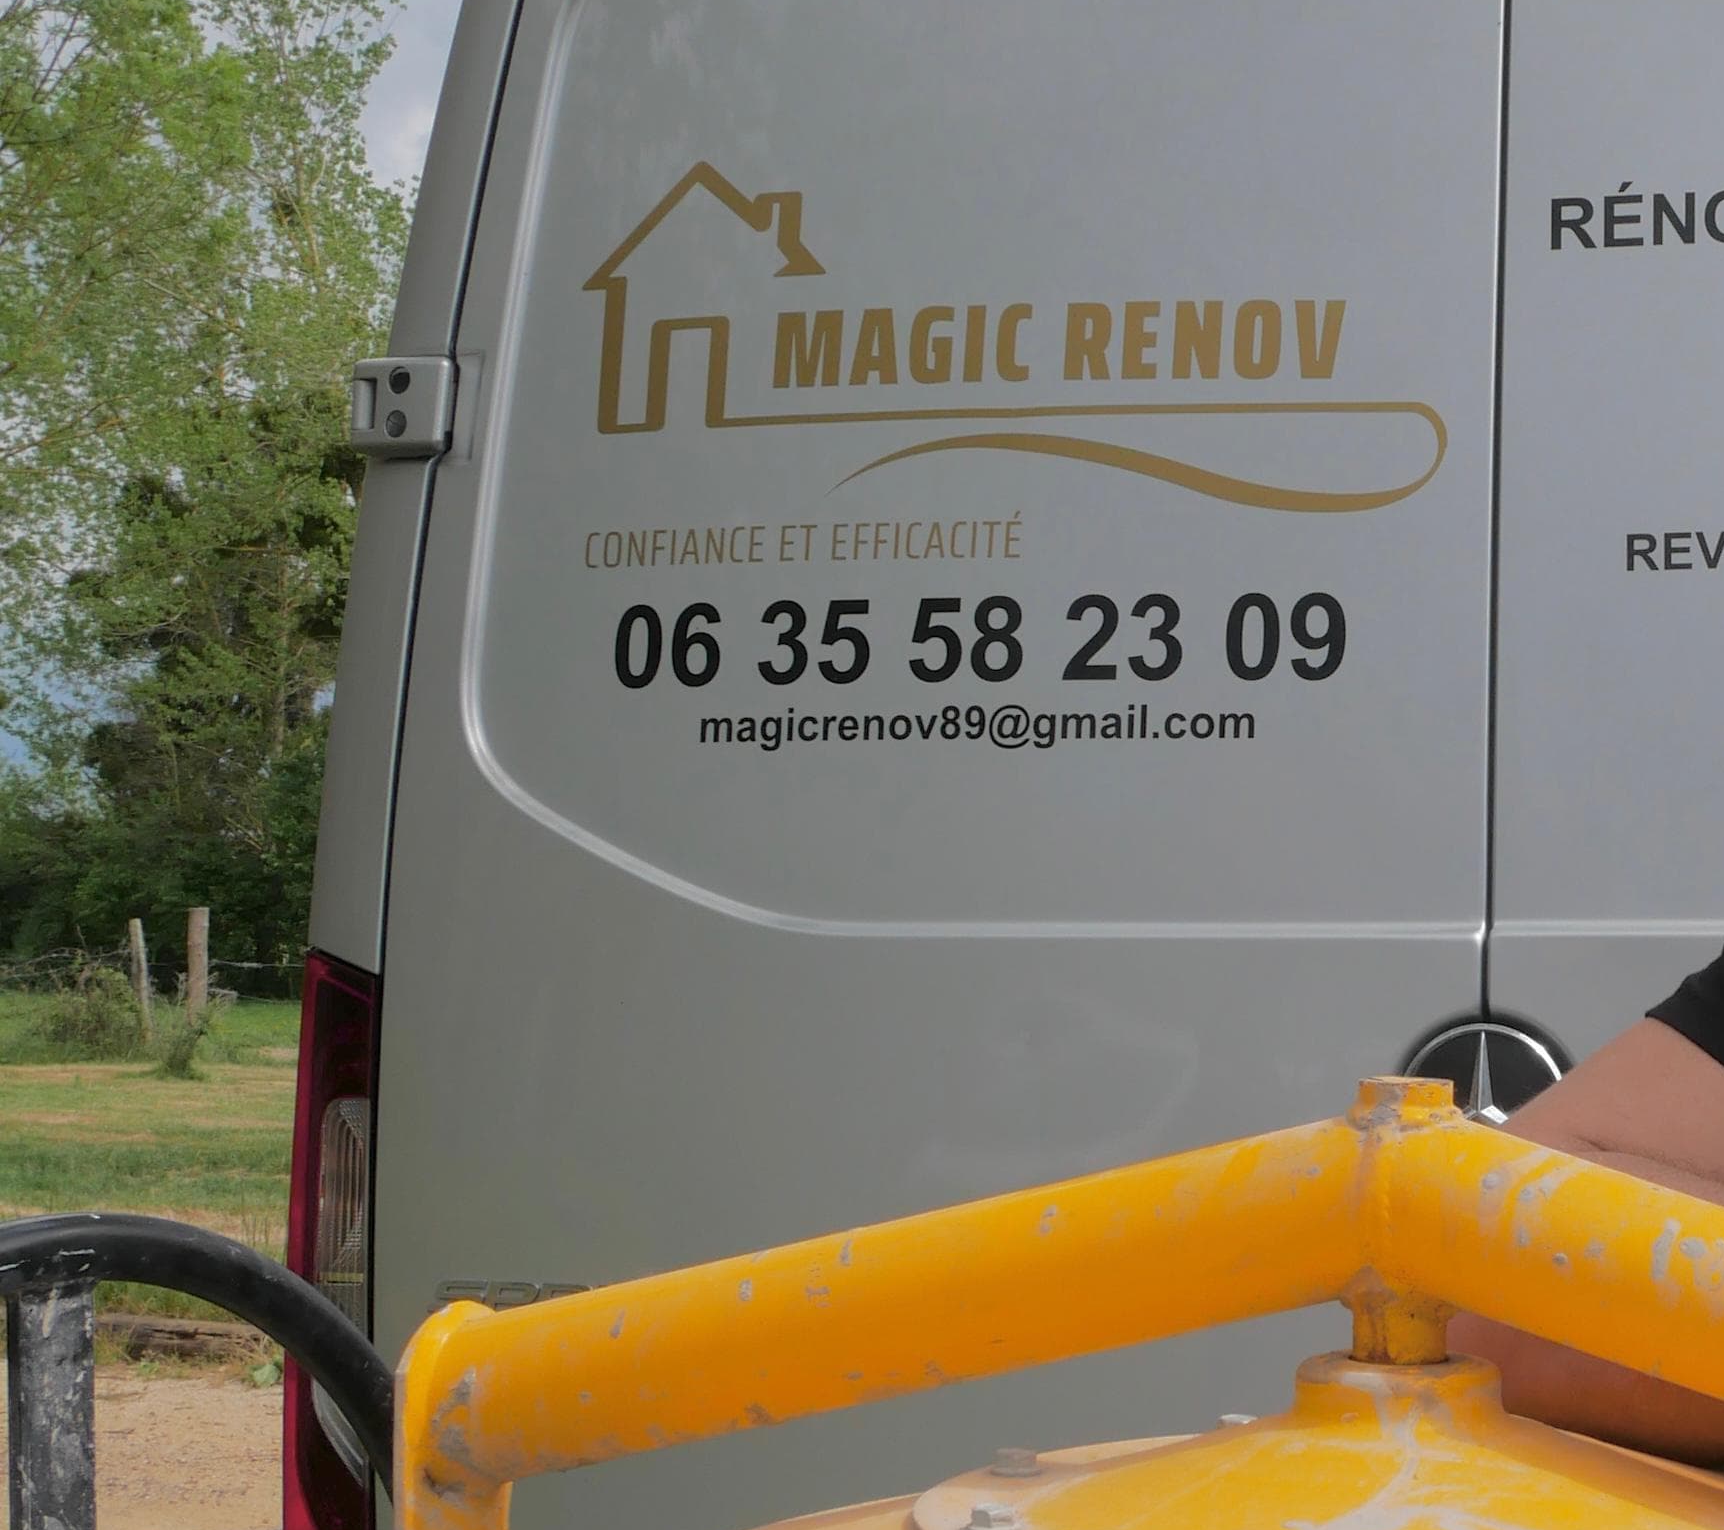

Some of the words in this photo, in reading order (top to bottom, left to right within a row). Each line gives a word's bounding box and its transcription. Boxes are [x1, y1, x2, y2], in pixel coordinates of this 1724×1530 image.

[773, 303, 1032, 388] MAGIC
[1063, 299, 1346, 380] RENOV
[584, 525, 765, 569] CONFIANCE
[779, 524, 818, 562] ET
[830, 511, 1022, 561] EFFICACITÉ
[613, 602, 722, 690] 06
[757, 598, 871, 686] 35
[908, 595, 1024, 684] 58
[1061, 593, 1183, 682] 23
[1225, 592, 1347, 682] 09
[699, 704, 1256, 752] magicrenov89@gmail.com
